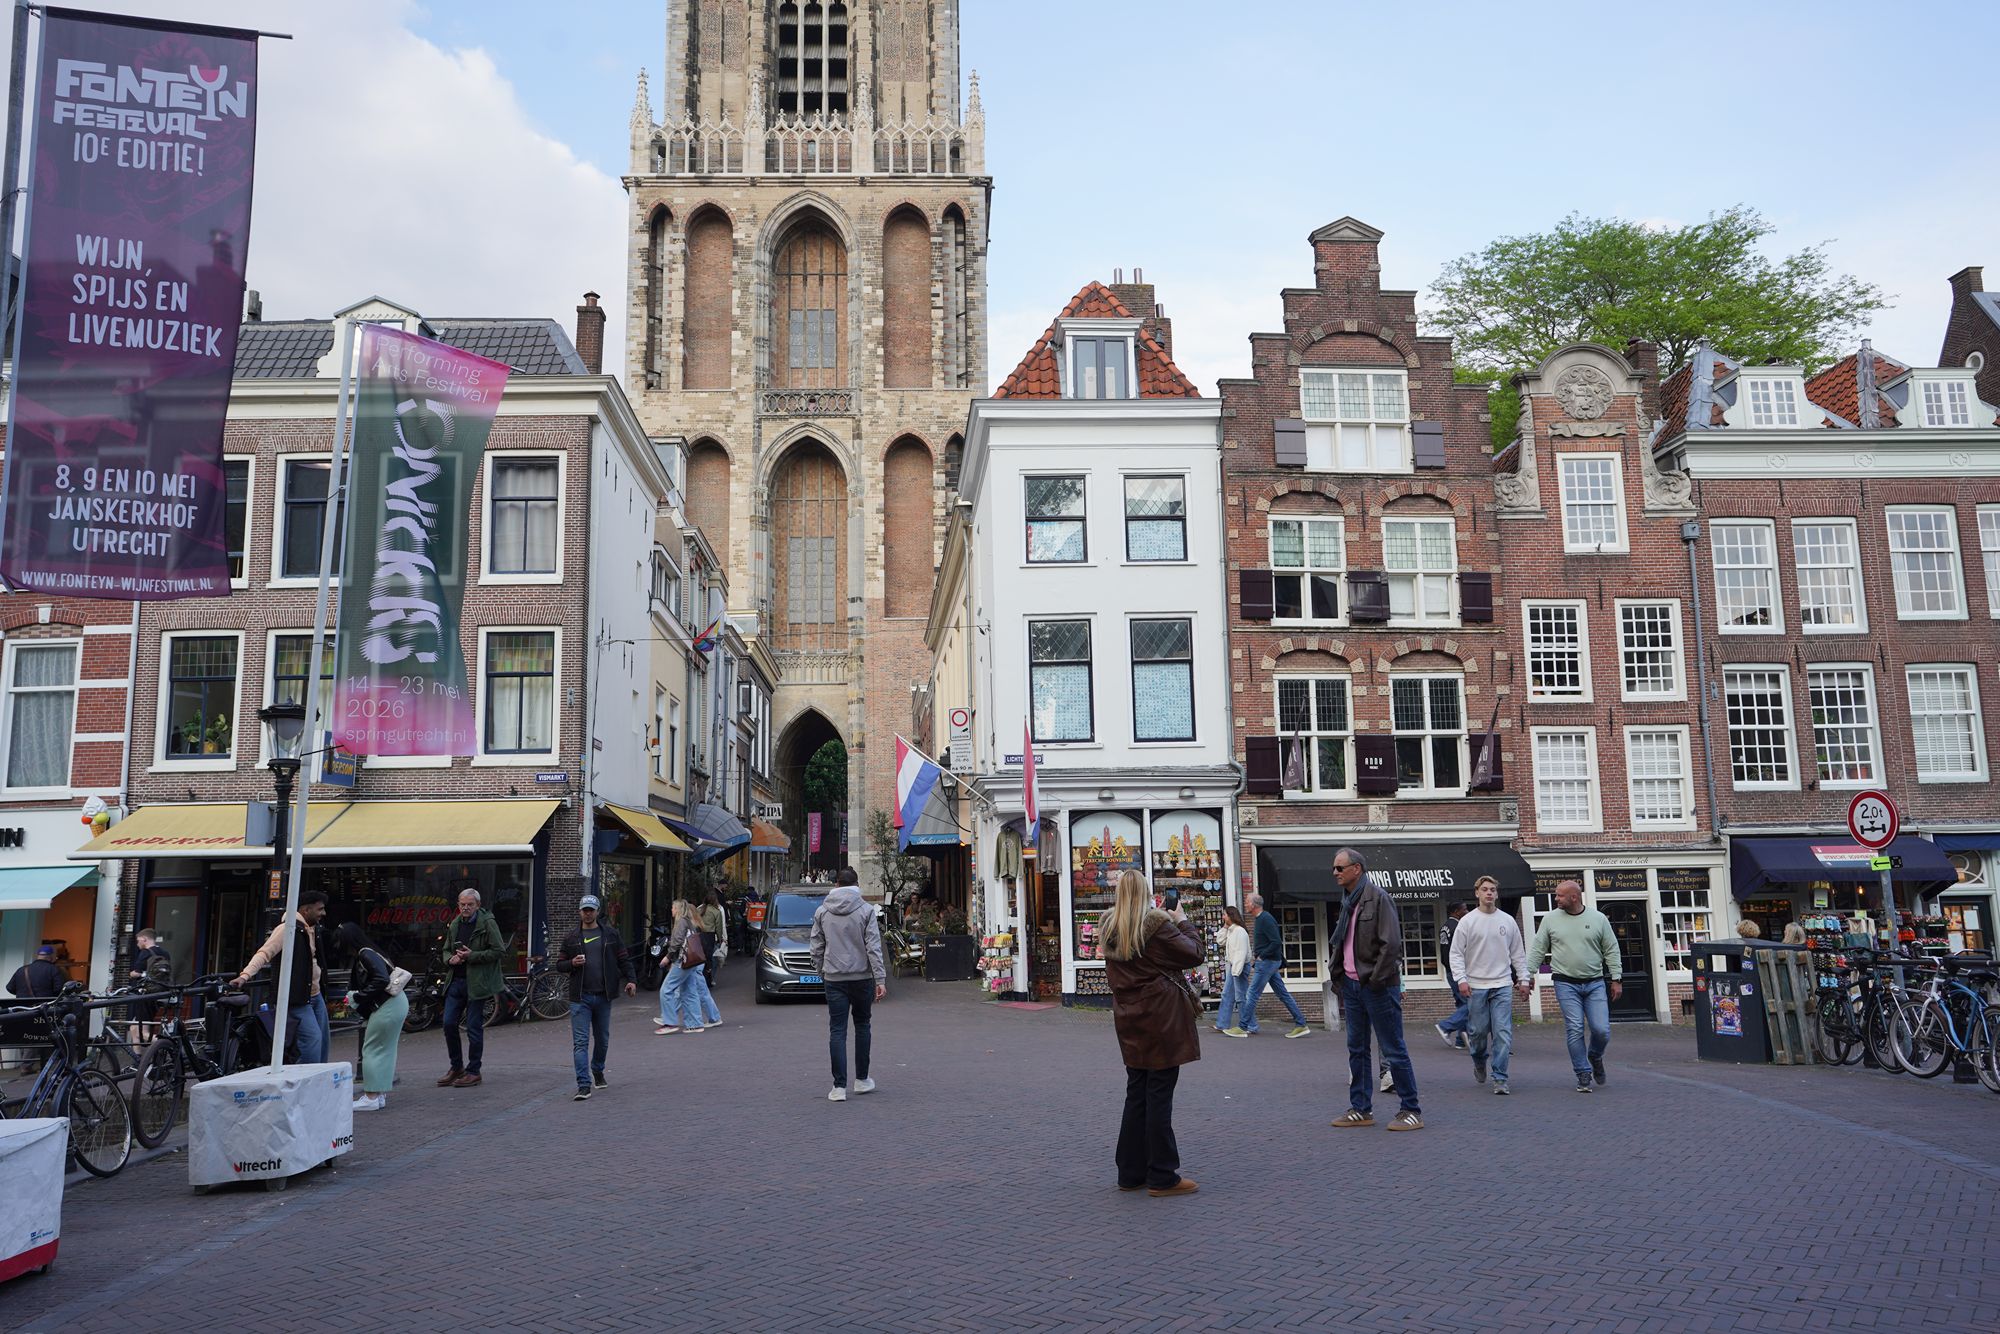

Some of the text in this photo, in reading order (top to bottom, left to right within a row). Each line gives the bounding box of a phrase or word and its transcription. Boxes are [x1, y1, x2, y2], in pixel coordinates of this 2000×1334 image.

[55, 59, 248, 121] FONTEYN
[53, 100, 206, 140] FESTIVAL
[117, 137, 204, 177] EDITIE!
[76, 233, 152, 277] WIJN,
[72, 273, 188, 313] SPIJS EN
[68, 312, 223, 357] LIVEMUZIEK
[377, 335, 482, 385] Performing
[372, 356, 489, 404] Arts Festival
[83, 467, 97, 491] 9
[103, 469, 129, 493] EN
[135, 470, 156, 495] 10
[162, 473, 196, 499] MEI
[49, 496, 199, 529] JANSKERKHOF
[72, 527, 171, 557] UTRECHT
[21, 571, 214, 593] WWW.FONTEYN-WIJNFESTIVAL.NL
[432, 681, 460, 700] mei
[347, 699, 405, 718] 2026
[345, 728, 466, 744] springutrecht.nl
[323, 760, 354, 776] ADERSON
[1395, 869, 1454, 887] PANCAKES
[233, 1158, 282, 1173] Utrecht
